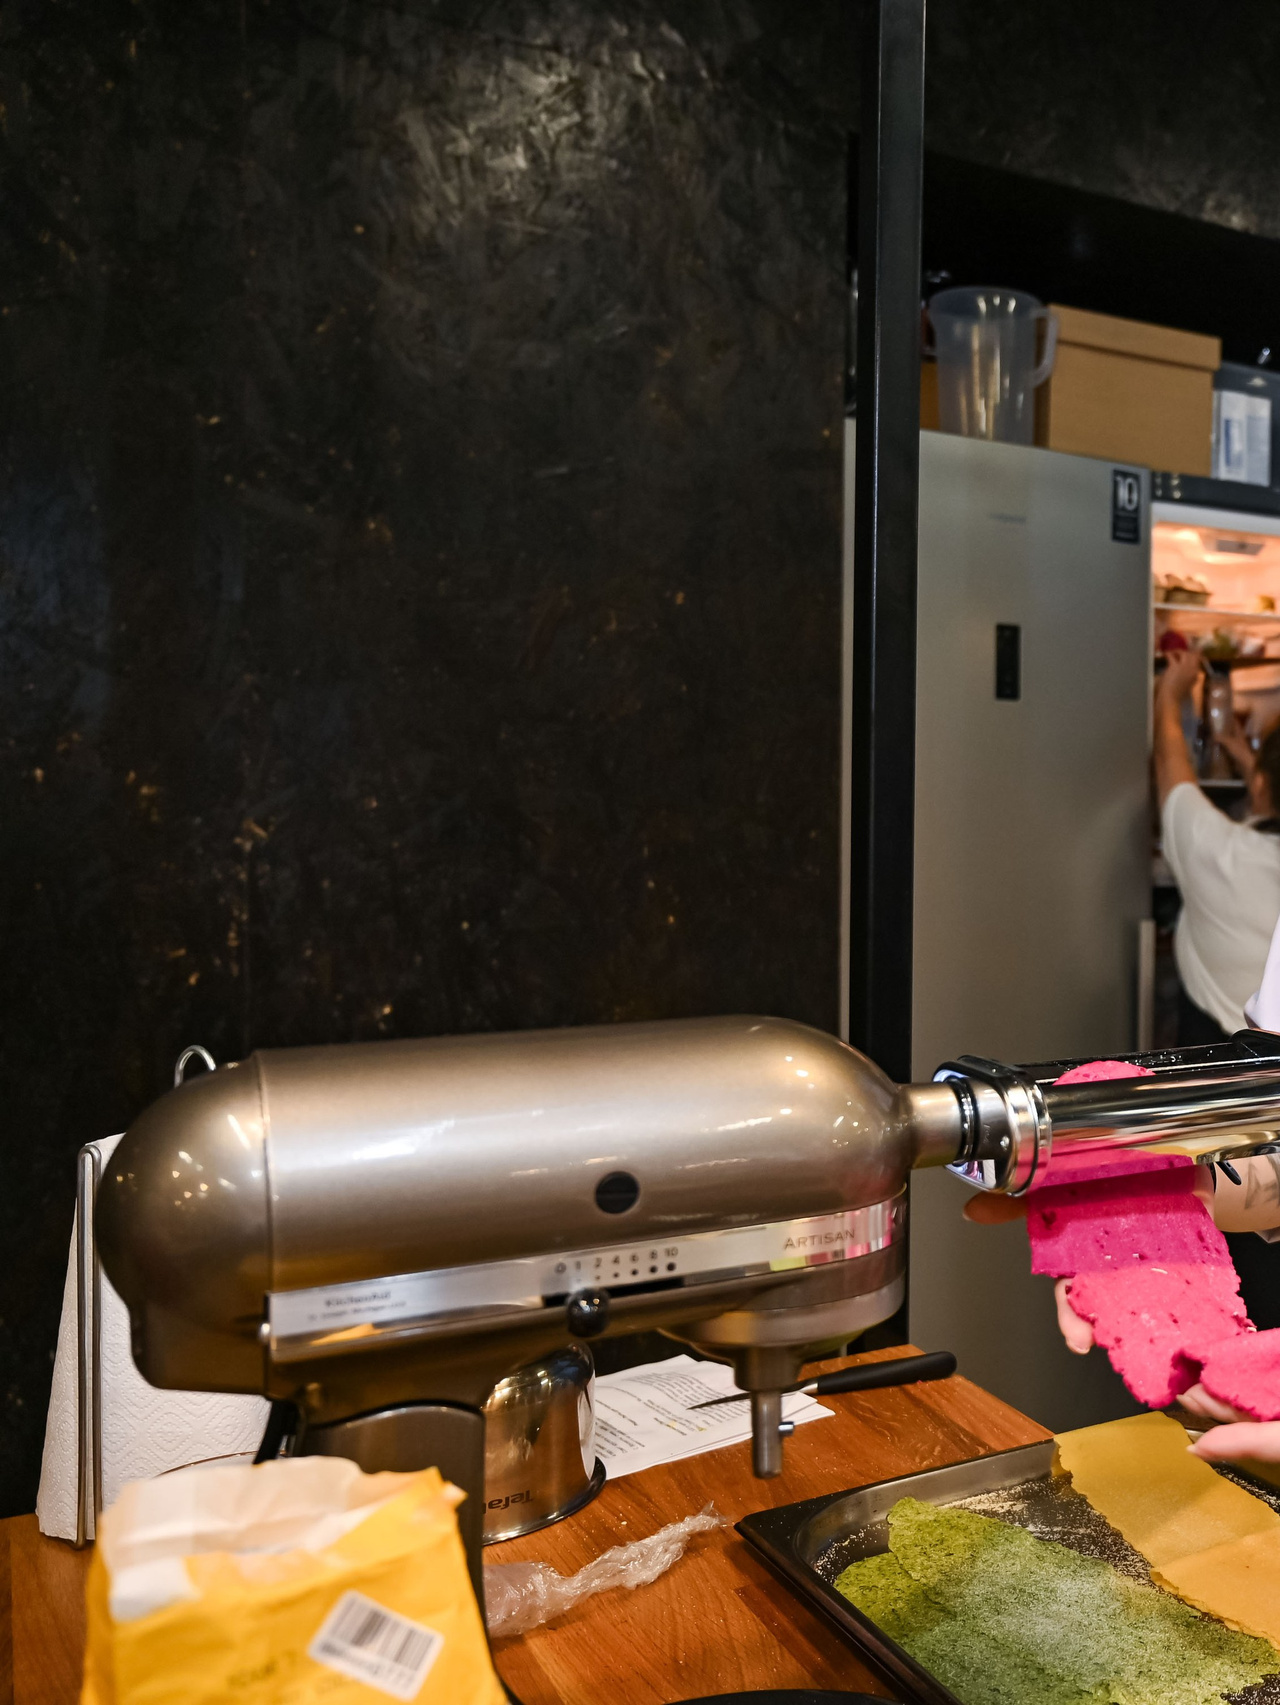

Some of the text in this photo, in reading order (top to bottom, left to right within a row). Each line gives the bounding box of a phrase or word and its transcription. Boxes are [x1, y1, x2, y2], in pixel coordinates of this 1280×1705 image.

[1115, 475, 1138, 511] 10
[783, 1228, 855, 1251] ARTISAN
[595, 1257, 602, 1269] 2
[612, 1255, 620, 1265] 4
[631, 1253, 639, 1264] 6
[649, 1249, 658, 1261] 8
[664, 1246, 679, 1258] 10
